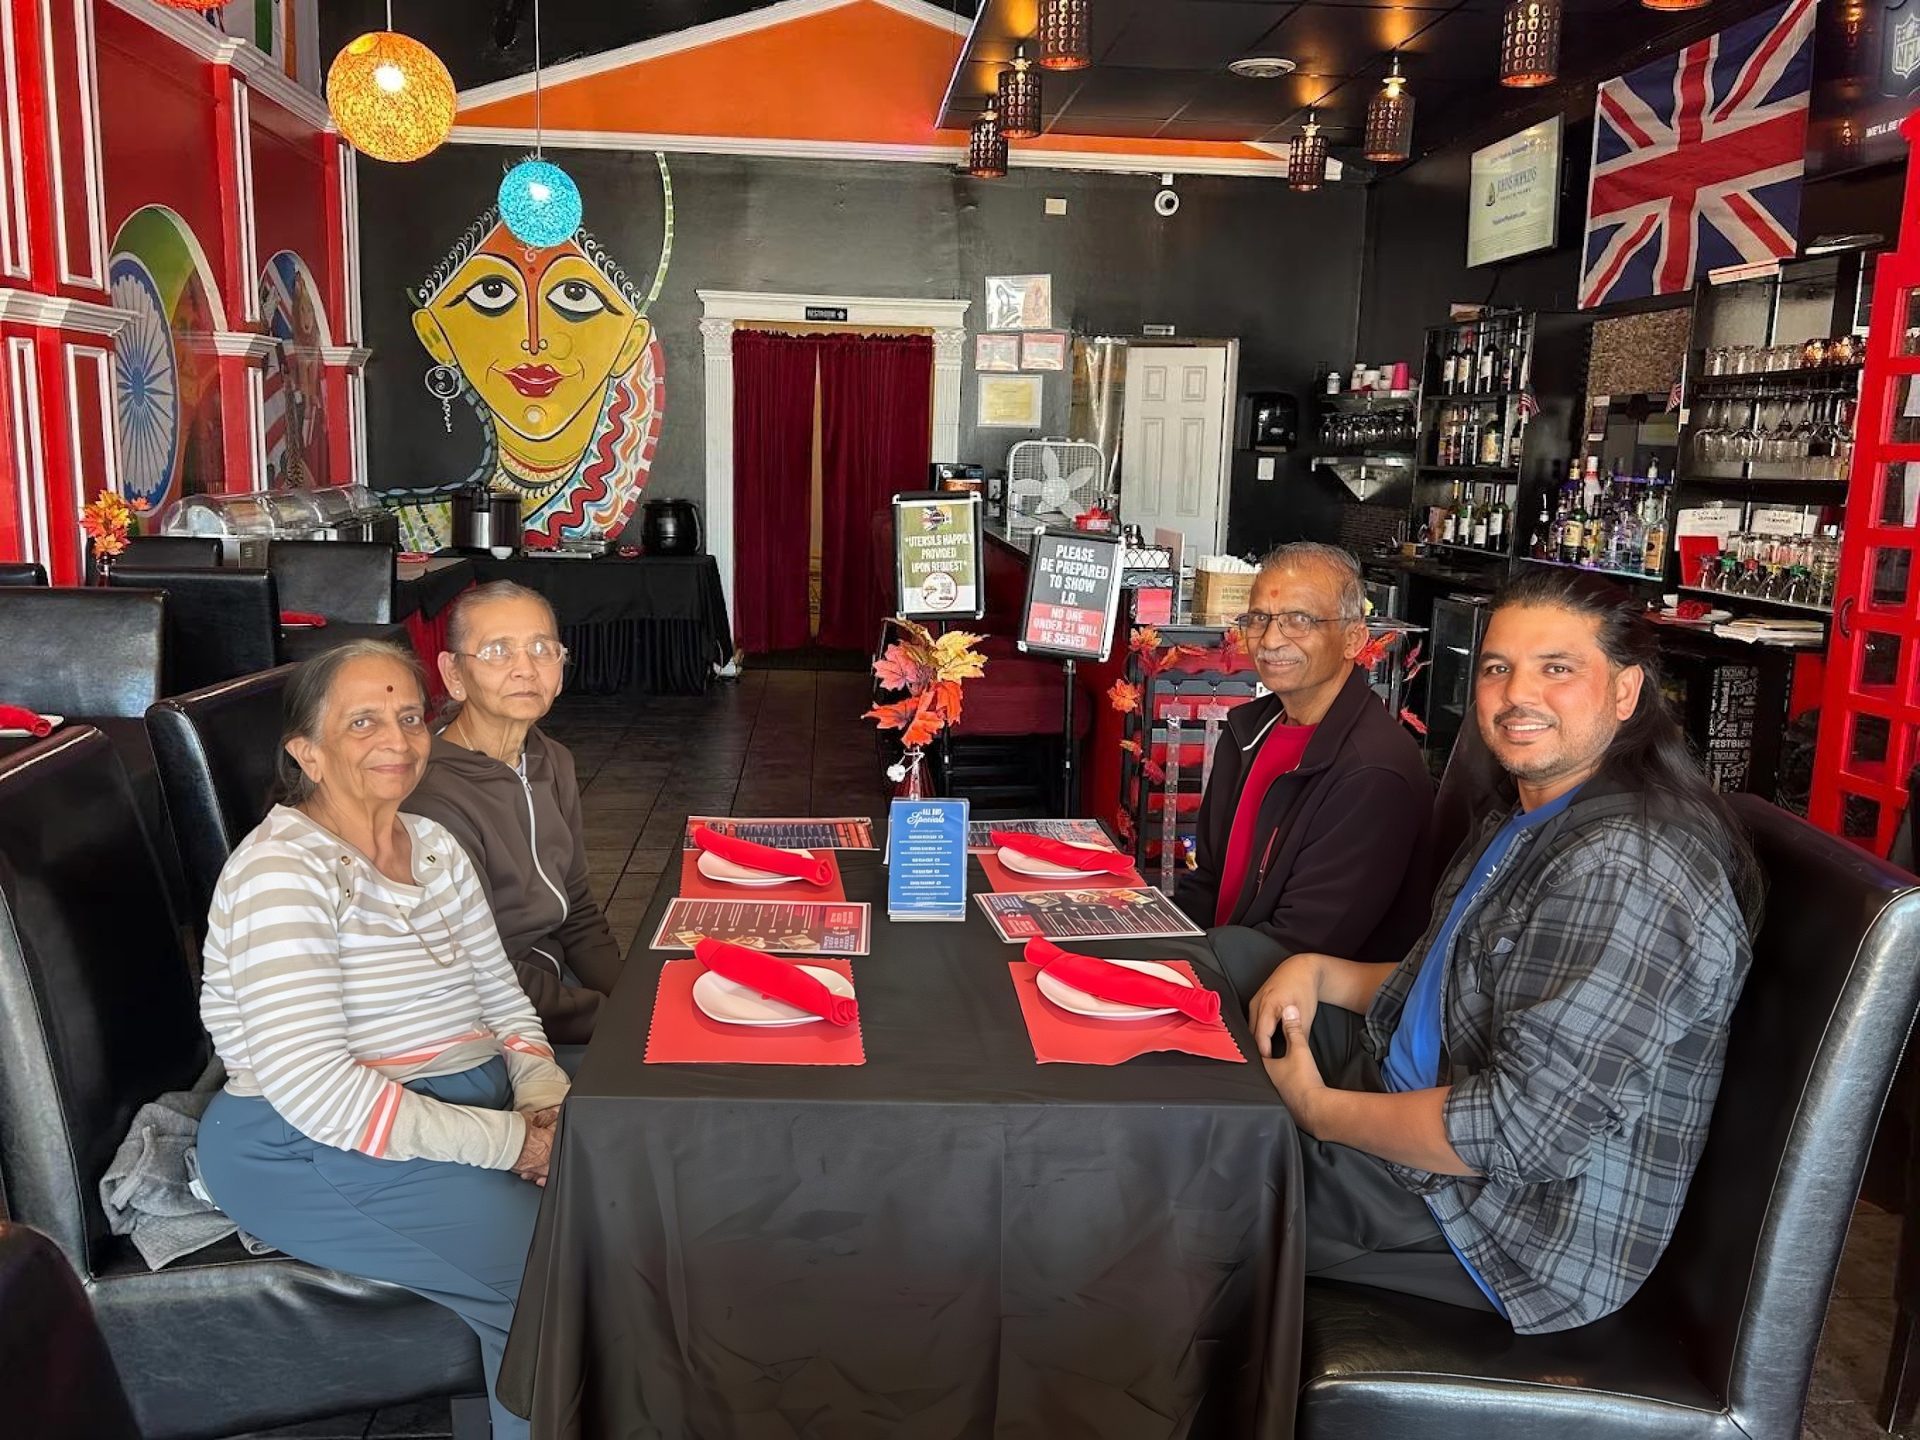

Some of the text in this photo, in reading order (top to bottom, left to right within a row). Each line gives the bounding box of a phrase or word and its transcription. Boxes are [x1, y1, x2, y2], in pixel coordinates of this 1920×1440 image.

[921, 548, 957, 560] PROVIDED
[1056, 544, 1095, 563] PLEASE
[911, 561, 931, 573] UPON
[1040, 557, 1109, 580] BE PREPARED
[1050, 574, 1096, 594] TO SHOW
[1051, 607, 1083, 622] NO ONE
[1033, 617, 1098, 637] UNDER 21 WILL
[1041, 630, 1088, 648] BE SERVED
[906, 811, 945, 828] Specials
